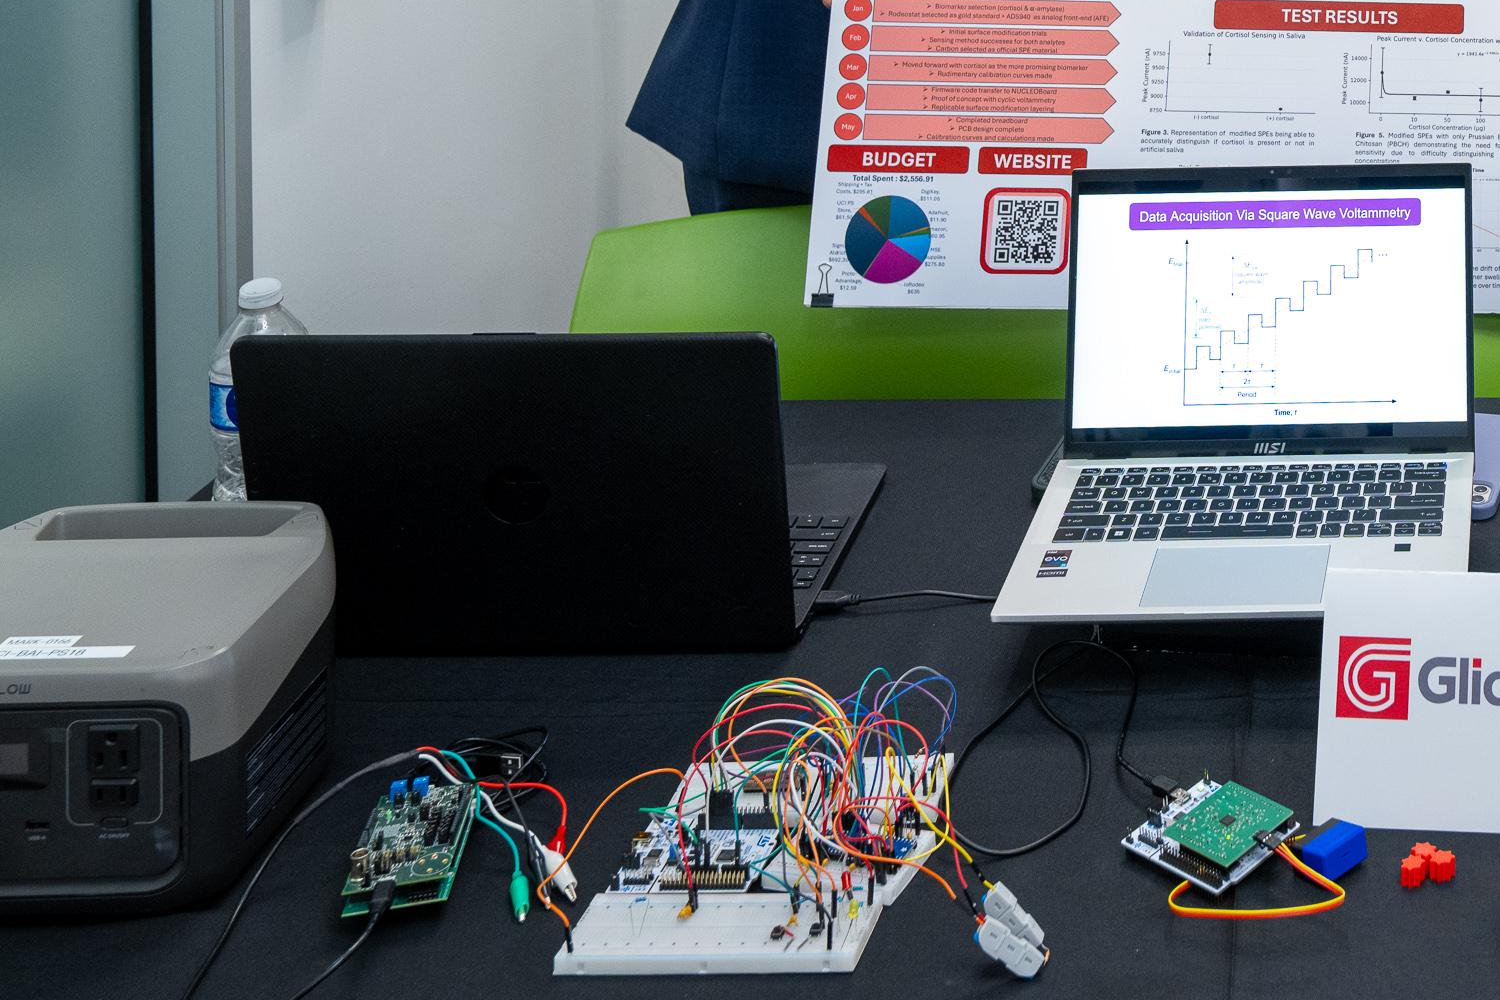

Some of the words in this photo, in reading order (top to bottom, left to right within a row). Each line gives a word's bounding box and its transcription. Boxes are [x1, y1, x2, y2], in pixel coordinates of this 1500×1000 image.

[852, 4, 864, 13] Jan
[1281, 8, 1322, 23] TEST
[1325, 9, 1398, 25] RESULTS
[849, 34, 862, 42] Feb
[1251, 31, 1277, 40] Sensing
[846, 63, 859, 71] Mar
[844, 92, 857, 102] Apr
[841, 123, 856, 132] May
[862, 151, 937, 167] BUDGET
[993, 153, 1072, 170] WEBSITE
[852, 174, 871, 182] Total
[871, 174, 894, 183] Spent
[898, 175, 934, 183] $2,556.91
[1139, 210, 1167, 222] Data
[1169, 209, 1233, 223] Acquisition
[1235, 209, 1255, 221] Via
[1258, 208, 1300, 223] Square
[1302, 207, 1336, 219] Wave
[1338, 207, 1411, 221] Voltammetry
[1274, 409, 1293, 417] Time,
